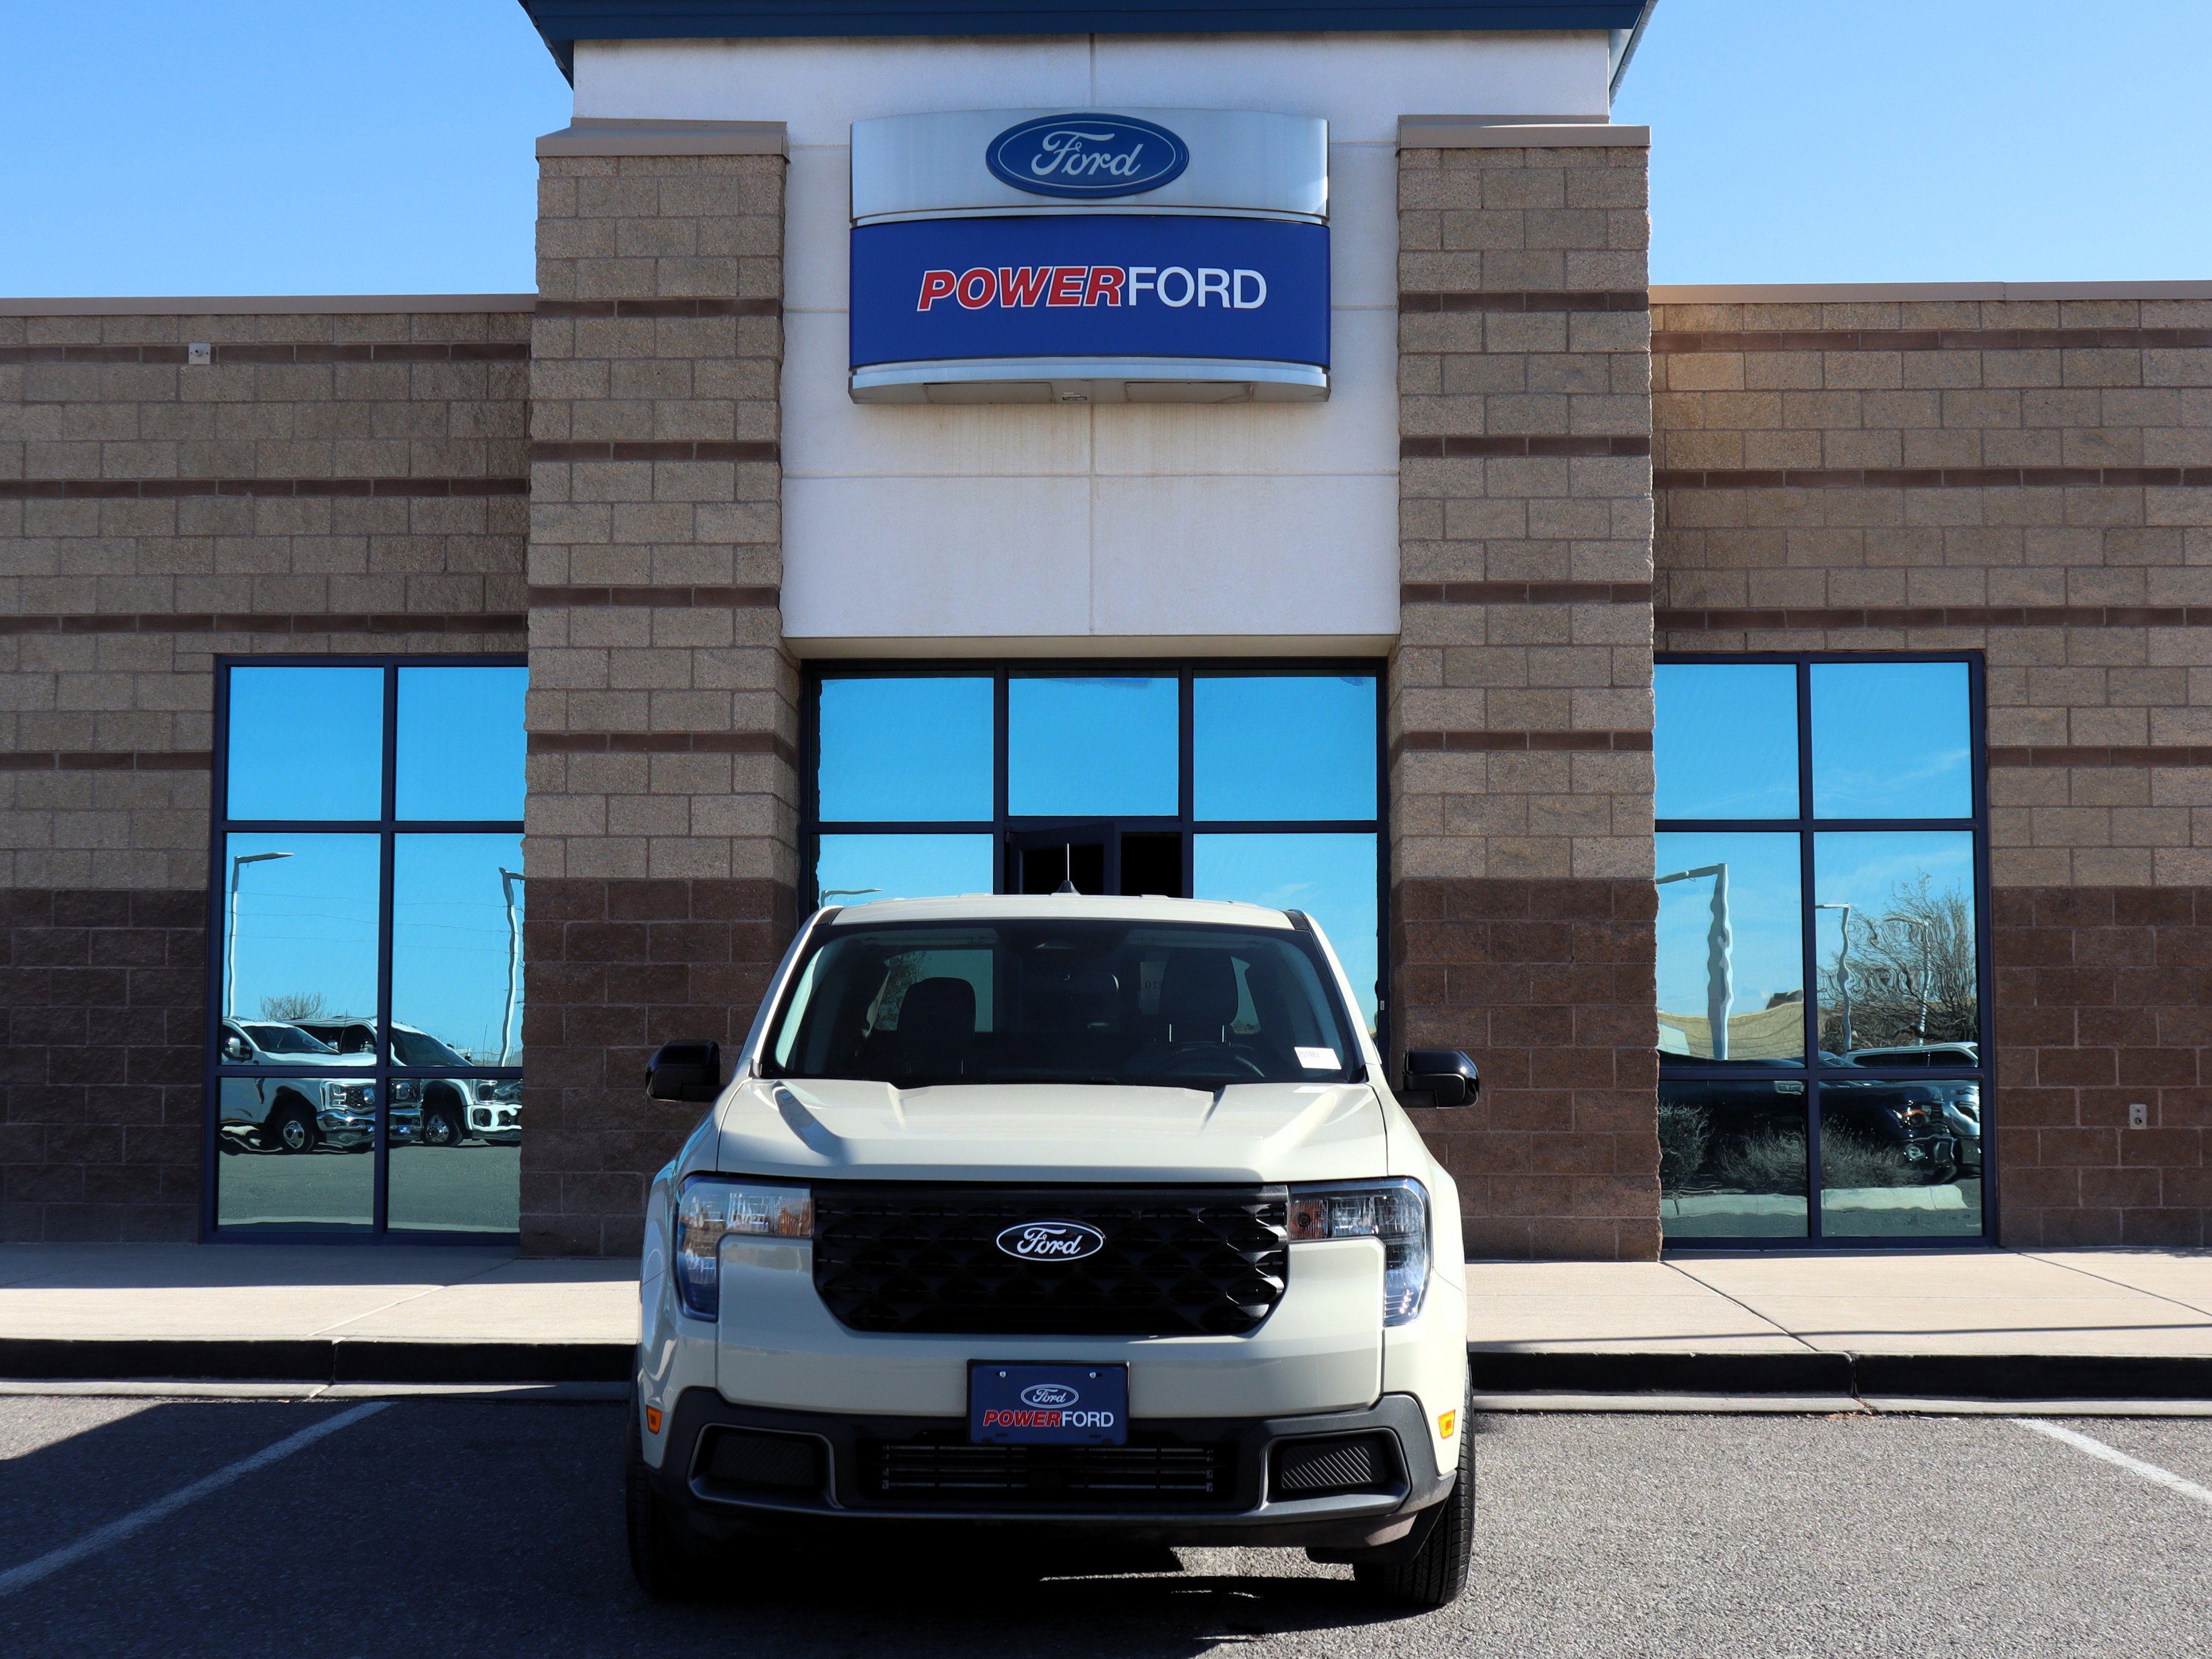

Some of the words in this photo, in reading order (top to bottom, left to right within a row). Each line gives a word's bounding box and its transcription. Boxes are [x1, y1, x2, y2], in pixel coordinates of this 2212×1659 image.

[1031, 131, 1144, 176] Ford
[916, 265, 1267, 312] POWERFORD
[1017, 1227, 1082, 1255] Ford
[1032, 1388, 1066, 1403] Ford
[983, 1410, 1114, 1427] POWERFORD
